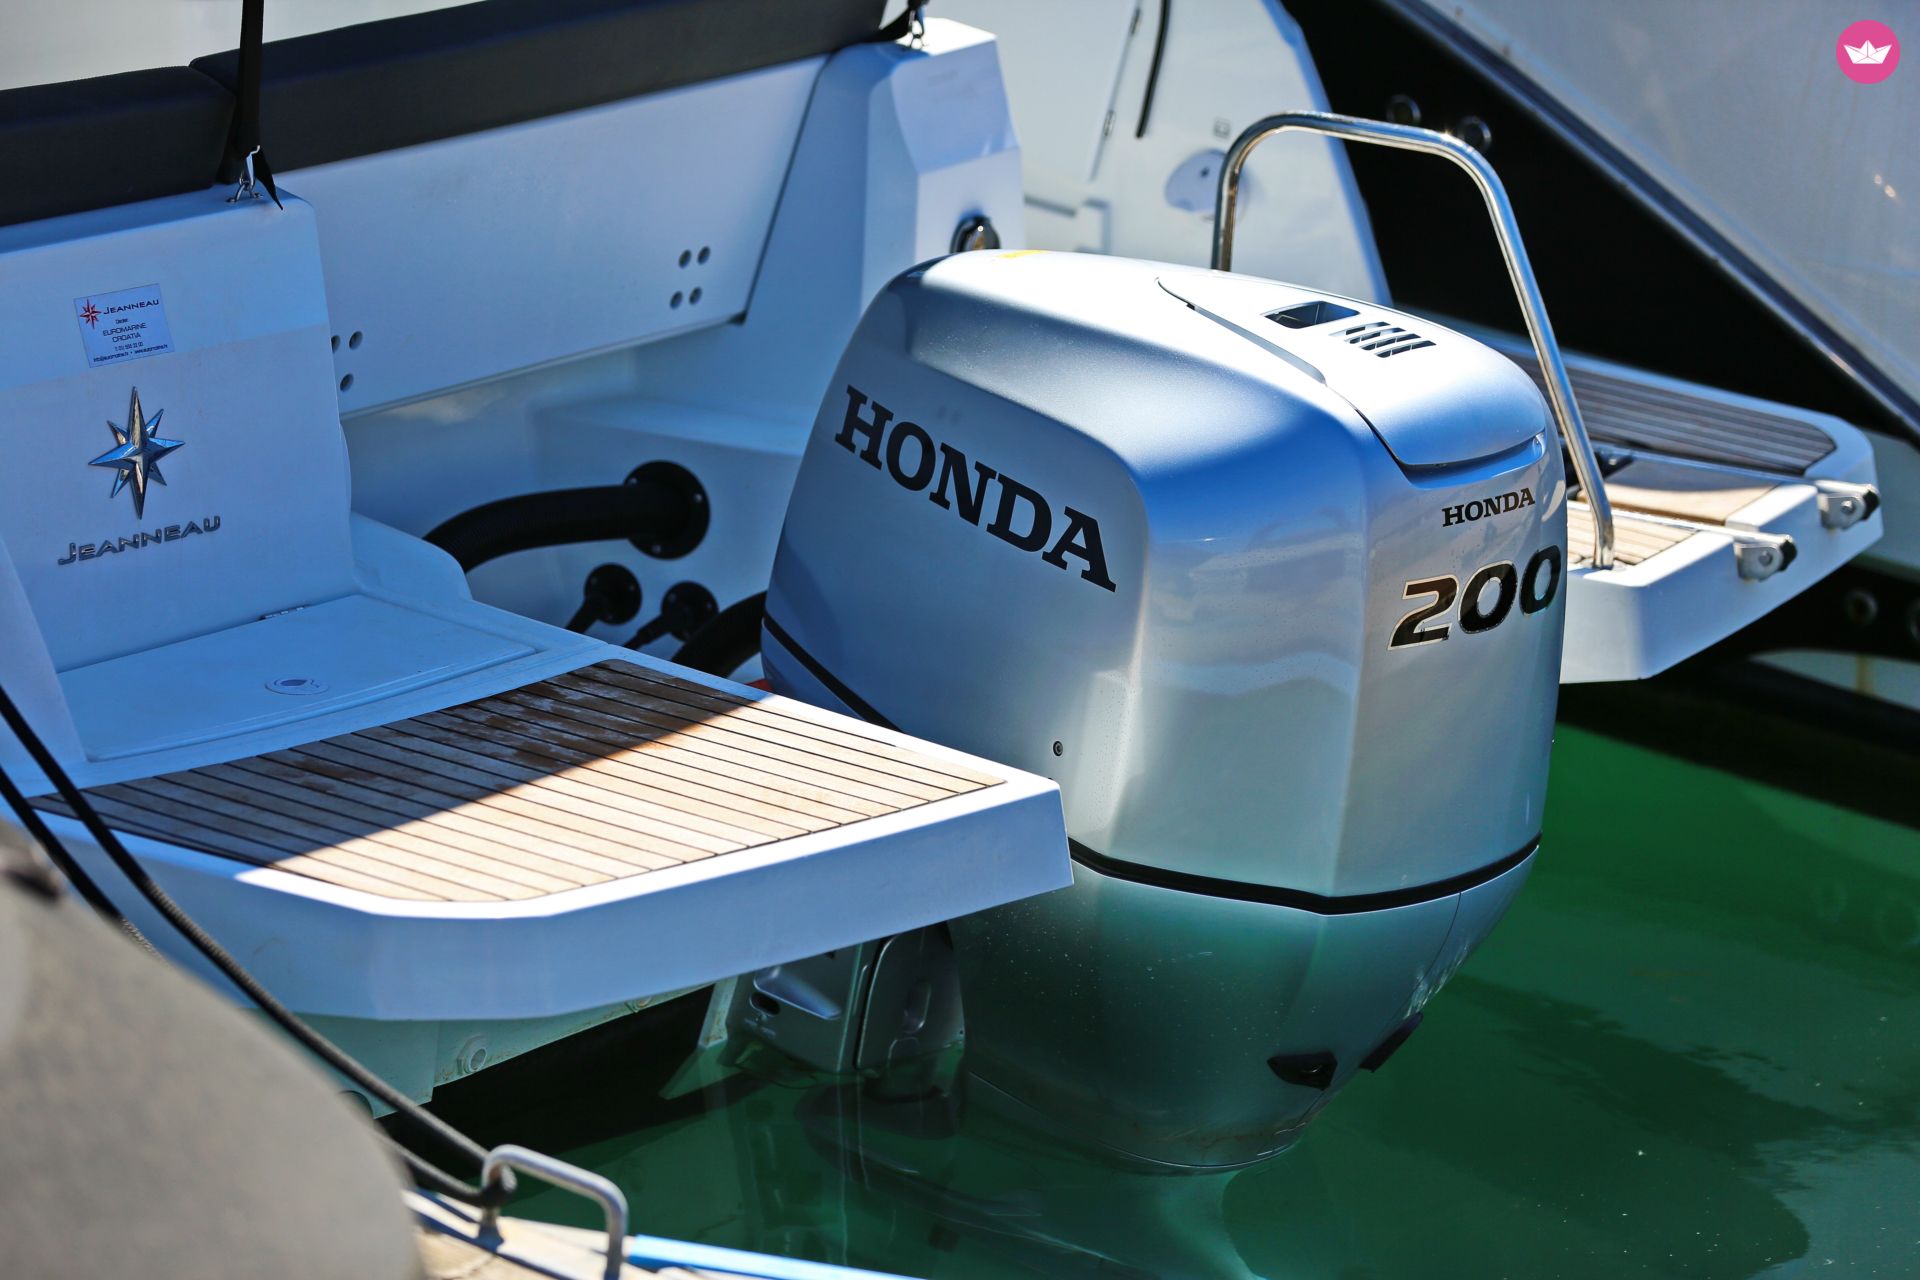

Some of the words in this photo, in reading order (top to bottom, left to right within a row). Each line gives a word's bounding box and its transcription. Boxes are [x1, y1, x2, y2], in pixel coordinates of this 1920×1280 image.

[103, 299, 160, 315] JEANNEAU
[102, 322, 147, 337] EUROMARINE
[111, 332, 142, 343] CROATIA
[834, 384, 1117, 593] HONDA
[1441, 487, 1536, 528] HONDA
[57, 515, 221, 566] JEANNEAU
[1387, 544, 1562, 651] 200
